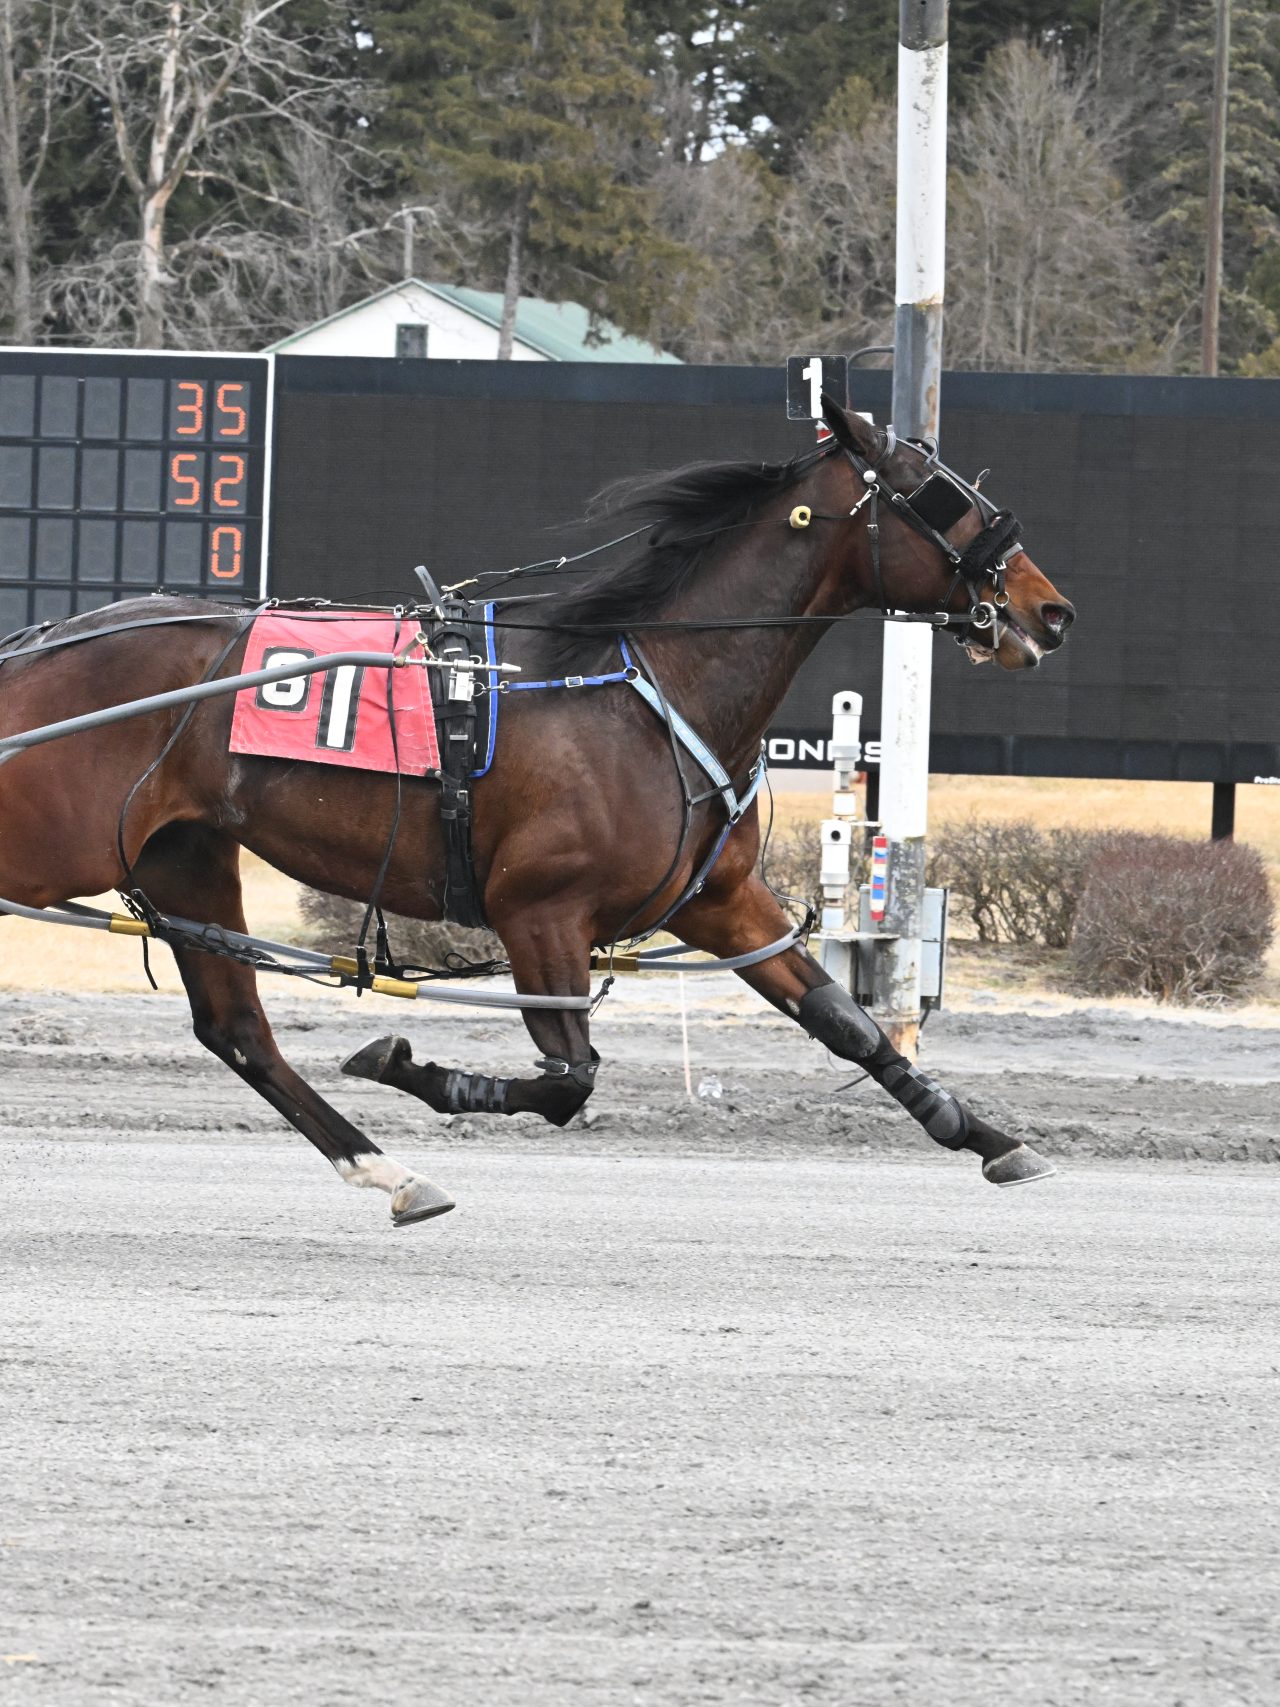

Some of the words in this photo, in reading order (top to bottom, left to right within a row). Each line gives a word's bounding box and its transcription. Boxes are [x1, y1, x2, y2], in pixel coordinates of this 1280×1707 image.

[177, 383, 246, 435] 35
[803, 358, 823, 419] 1
[171, 454, 244, 507] 52
[211, 526, 241, 578] 0
